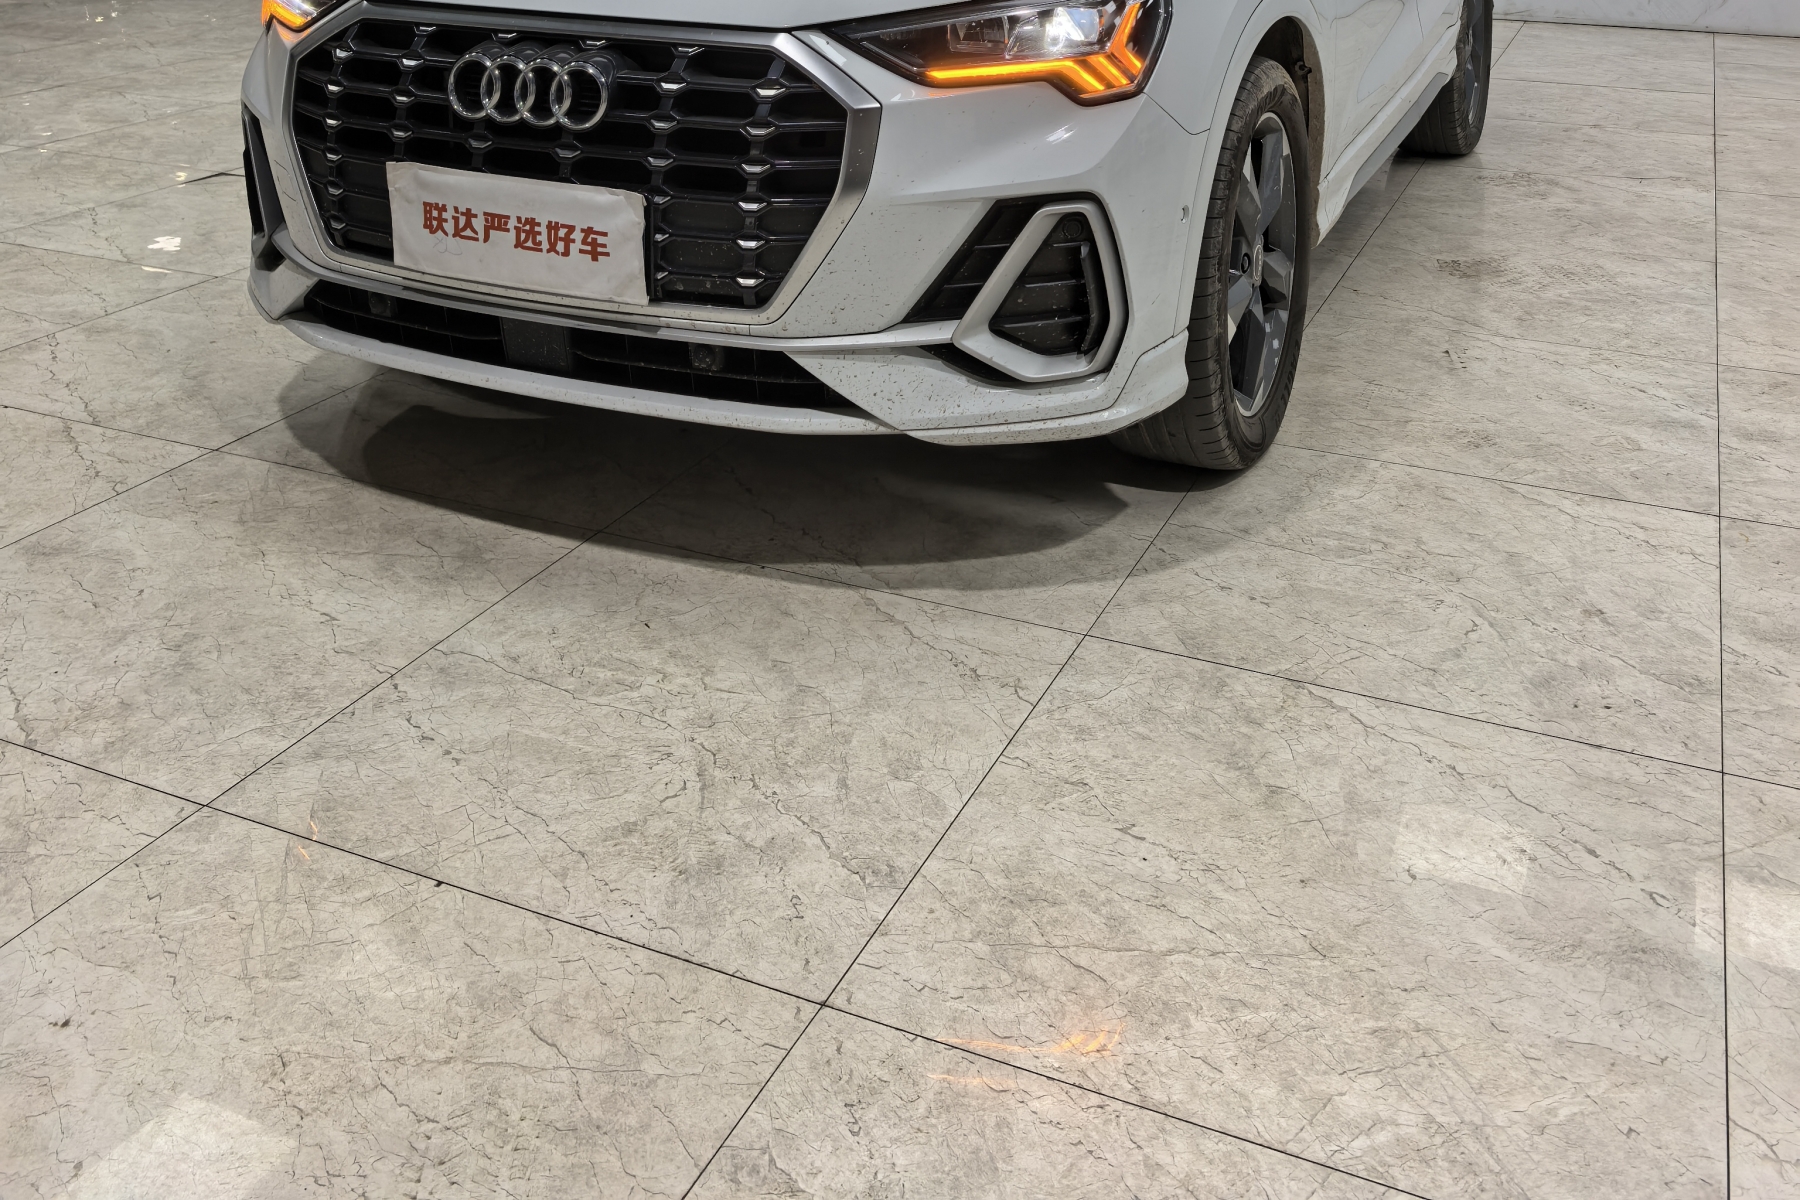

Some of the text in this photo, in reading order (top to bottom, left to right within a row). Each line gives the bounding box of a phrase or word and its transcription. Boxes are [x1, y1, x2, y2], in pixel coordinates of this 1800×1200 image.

[422, 200, 611, 262] 联达严选好车
